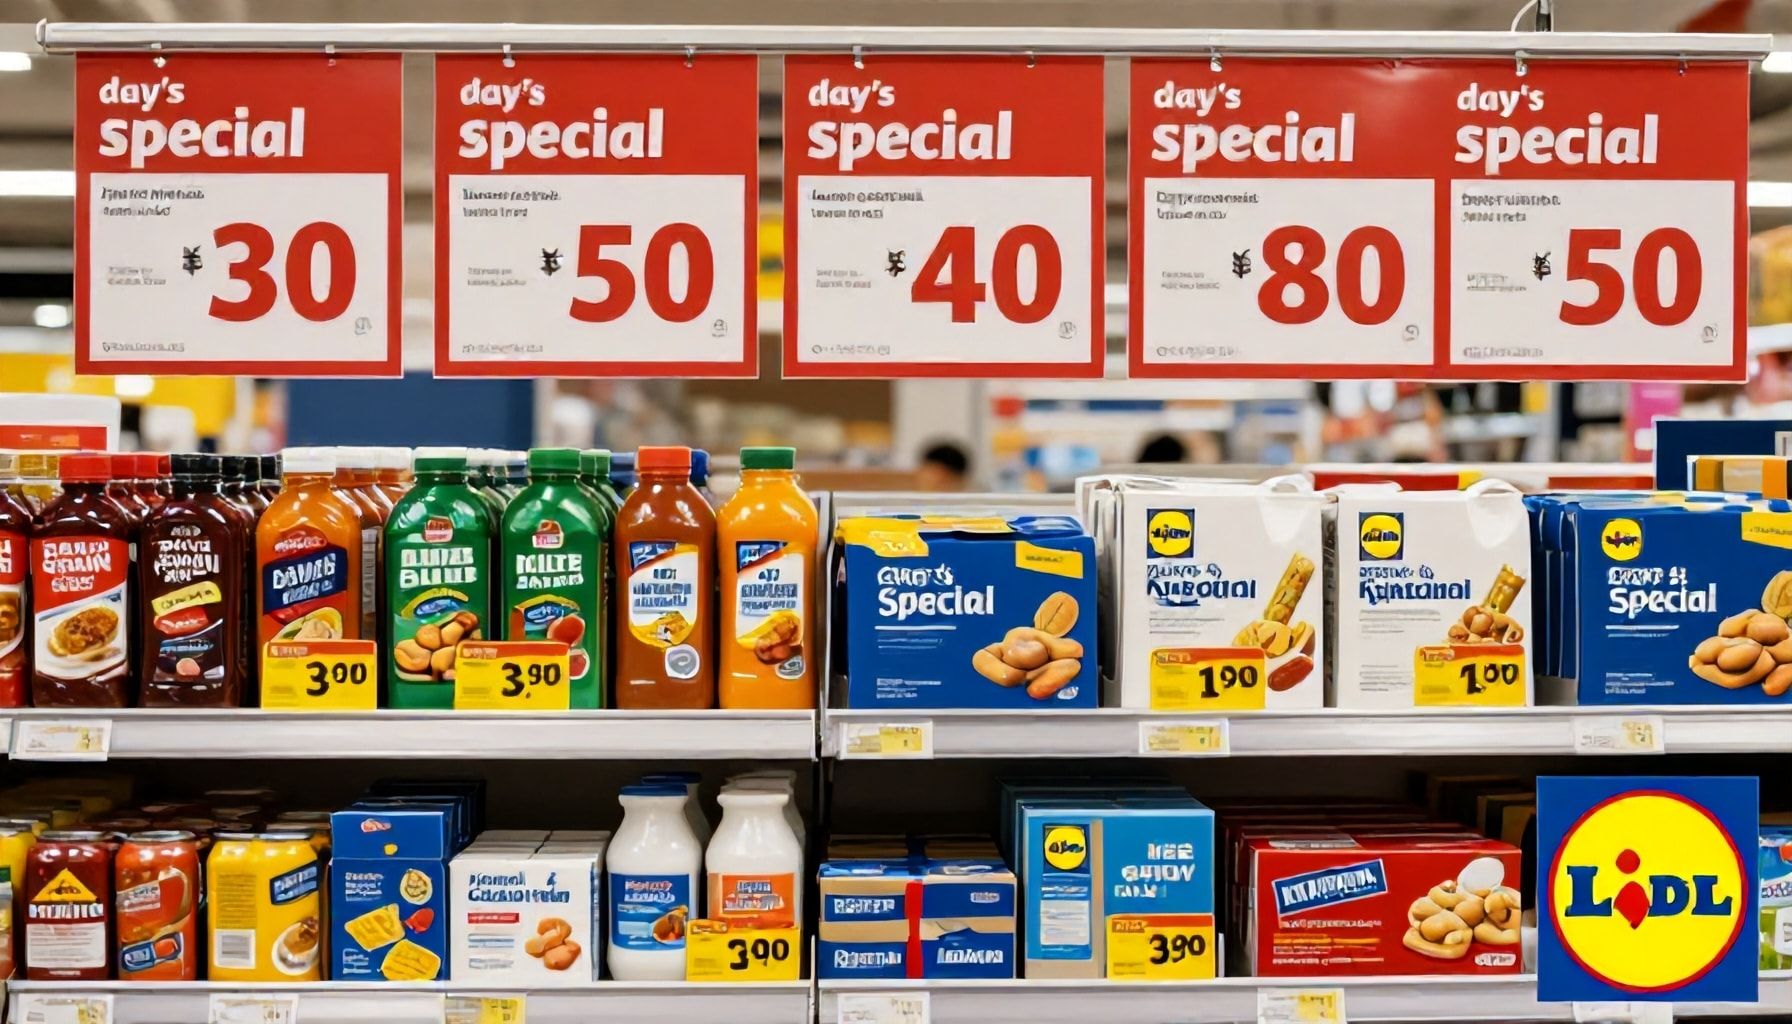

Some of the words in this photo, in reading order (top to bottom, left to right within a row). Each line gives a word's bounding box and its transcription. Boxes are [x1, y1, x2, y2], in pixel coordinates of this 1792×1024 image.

[100, 76, 185, 112] day's
[460, 77, 545, 113] day's
[808, 79, 895, 113] day's
[1153, 81, 1242, 117] day's
[1457, 83, 1544, 117] day's
[99, 107, 305, 168] special
[459, 107, 664, 170] special
[808, 109, 1012, 171] special
[1152, 110, 1355, 173] special
[1455, 112, 1658, 176] special
[878, 585, 995, 621] Special
[1608, 582, 1718, 620] Special
